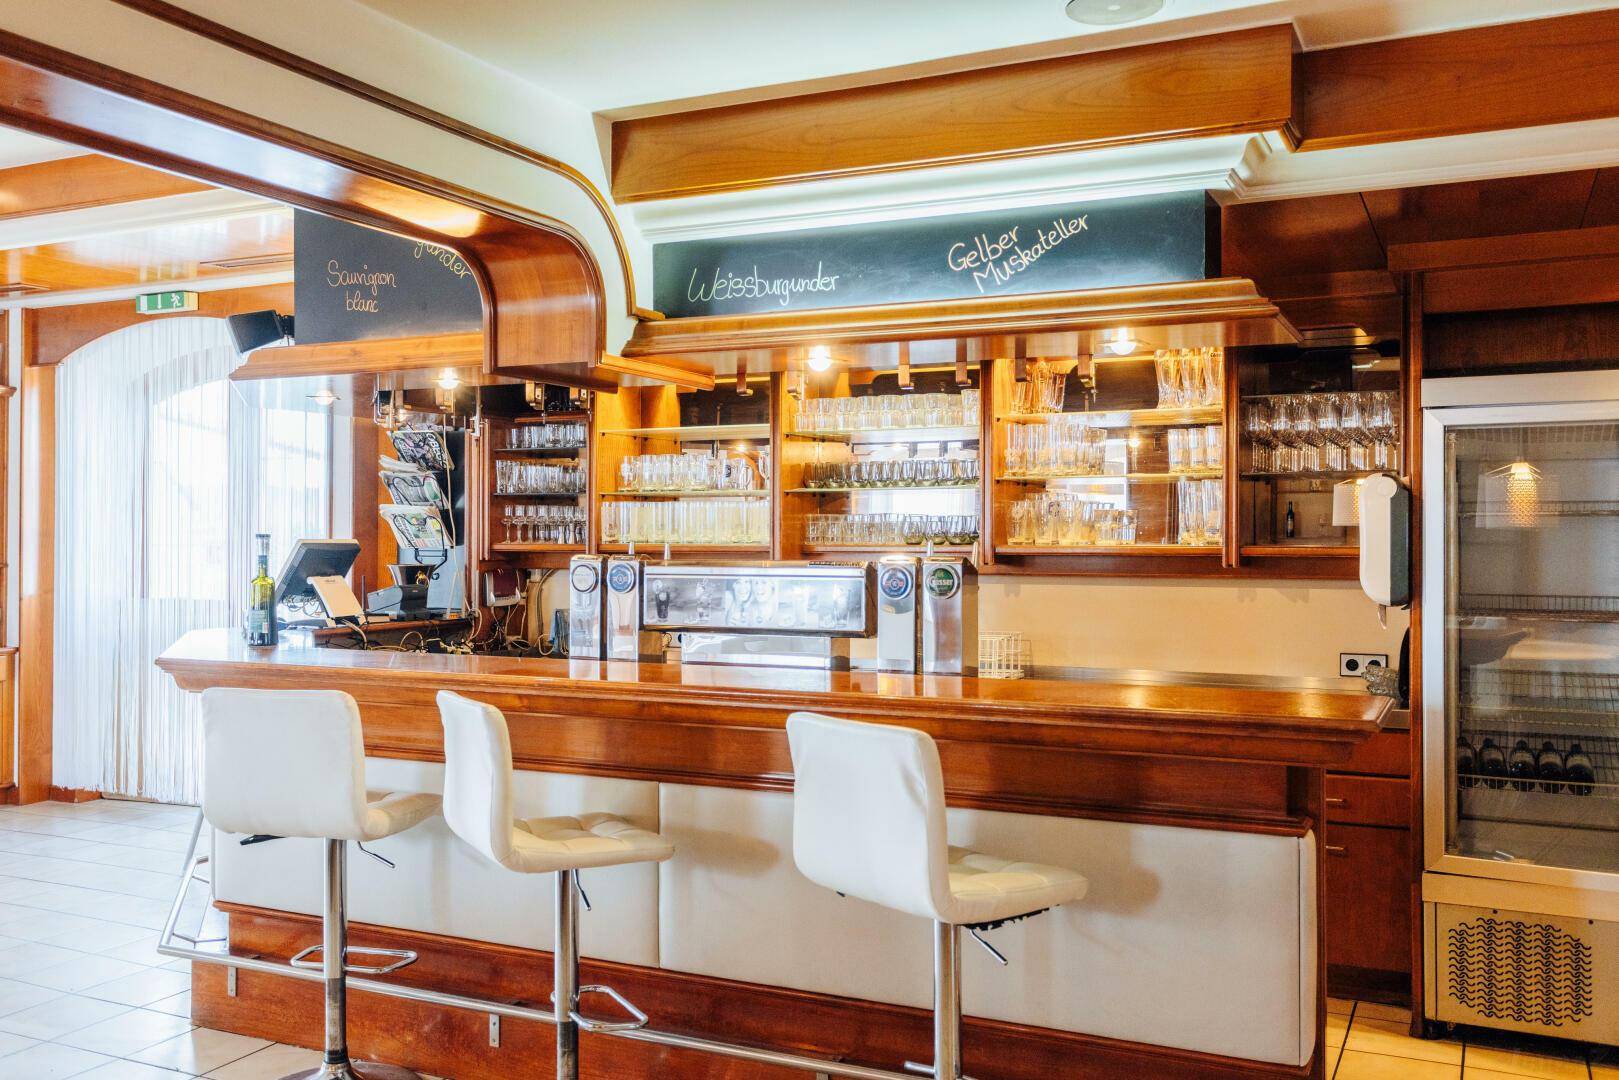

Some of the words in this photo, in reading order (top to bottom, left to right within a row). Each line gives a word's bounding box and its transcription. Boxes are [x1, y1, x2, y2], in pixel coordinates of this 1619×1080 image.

[945, 226, 1018, 271] Gelber
[972, 214, 1090, 294] Muskateller
[326, 259, 397, 297] Sauvignon
[687, 260, 841, 306] Weissburgunder
[345, 290, 379, 313] blanc
